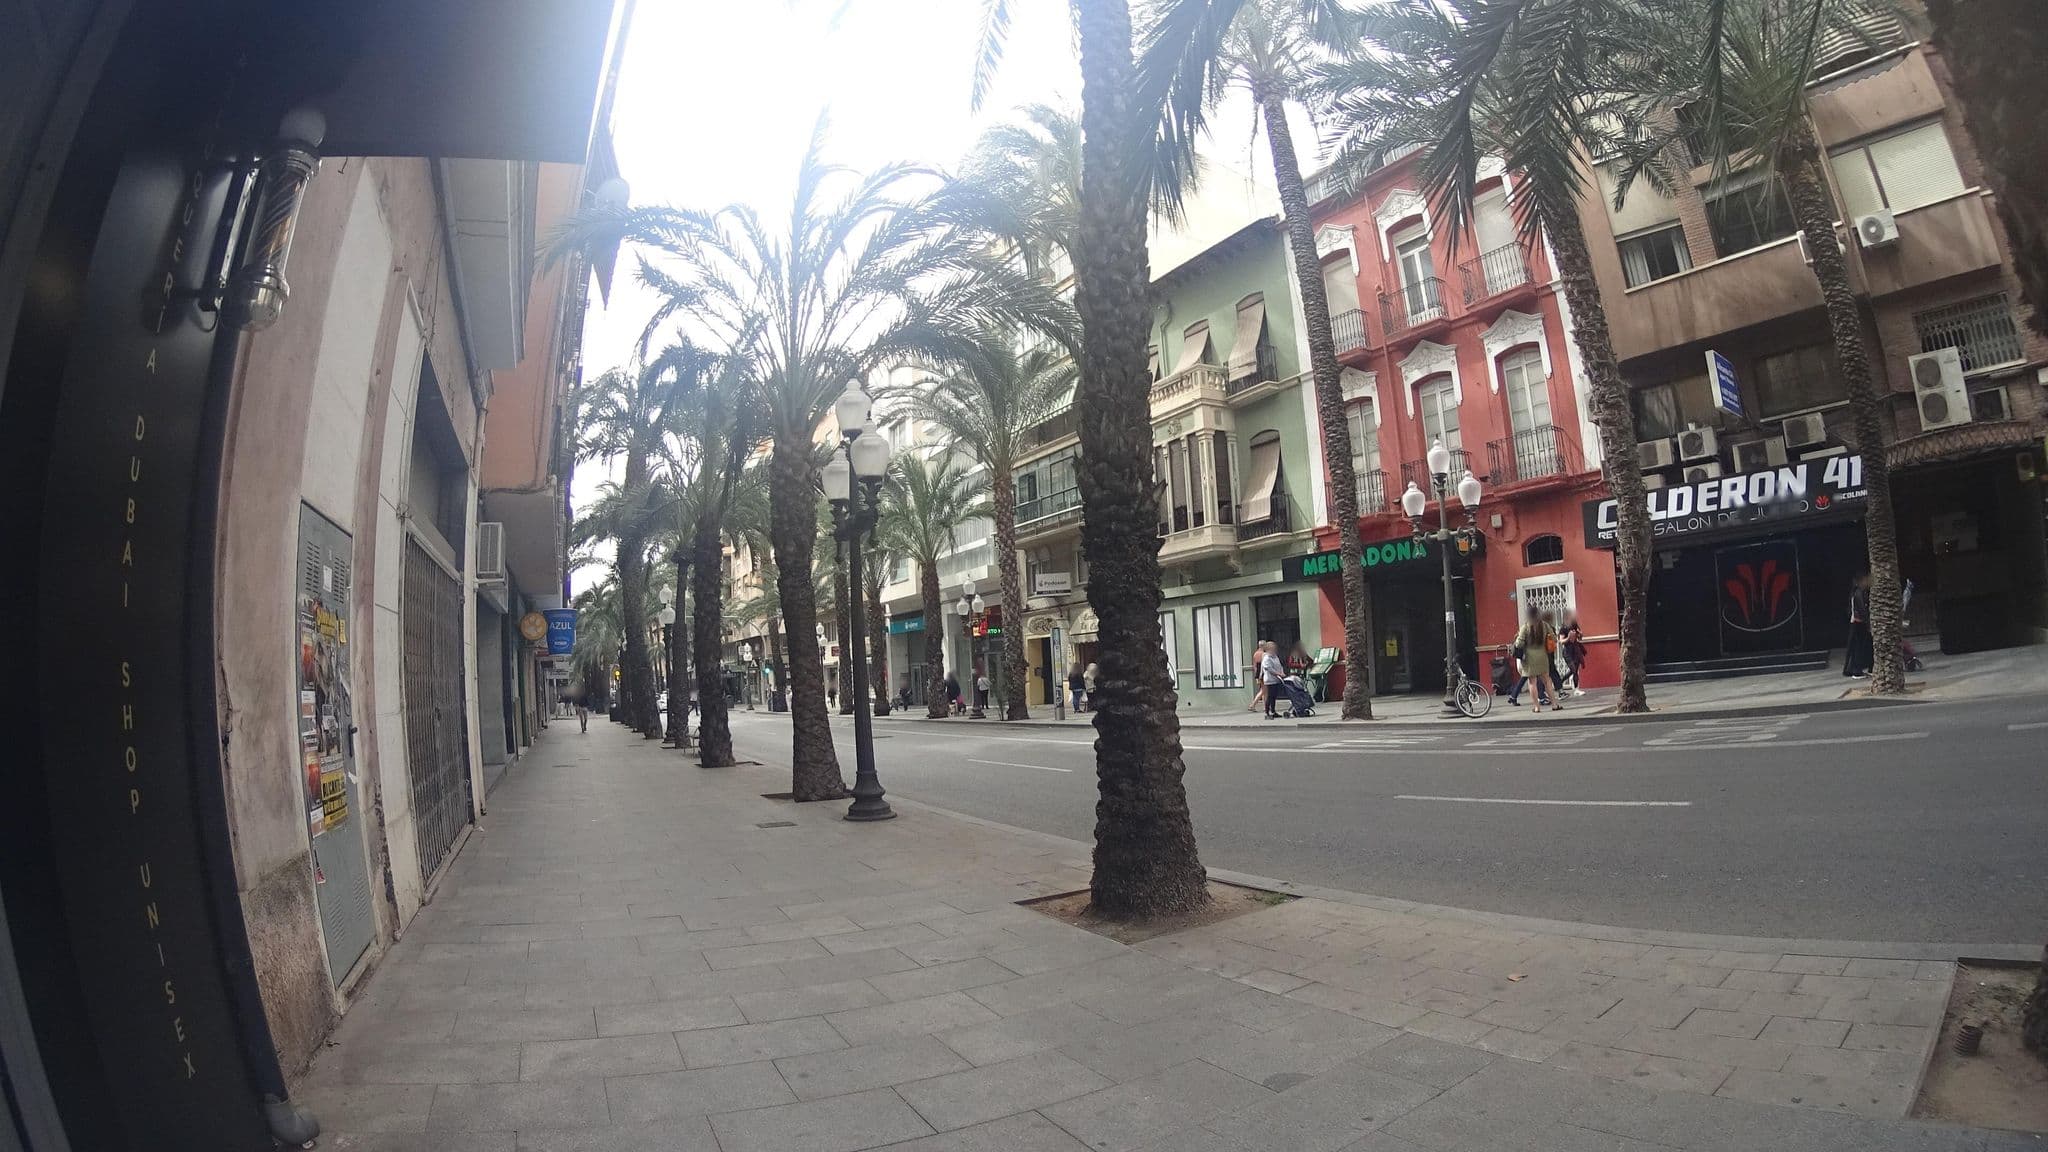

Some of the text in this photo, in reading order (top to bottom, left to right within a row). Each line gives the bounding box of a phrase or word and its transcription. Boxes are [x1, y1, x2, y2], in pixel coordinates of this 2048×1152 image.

[122, 416, 145, 607] DUBAI
[1597, 455, 1862, 529] CLDERON 41
[1653, 515, 1712, 536] SALON
[1303, 541, 1427, 576] MERDONA
[550, 621, 572, 630] AZUL
[121, 661, 140, 815] SHOP
[140, 864, 196, 1078] UNISEX
